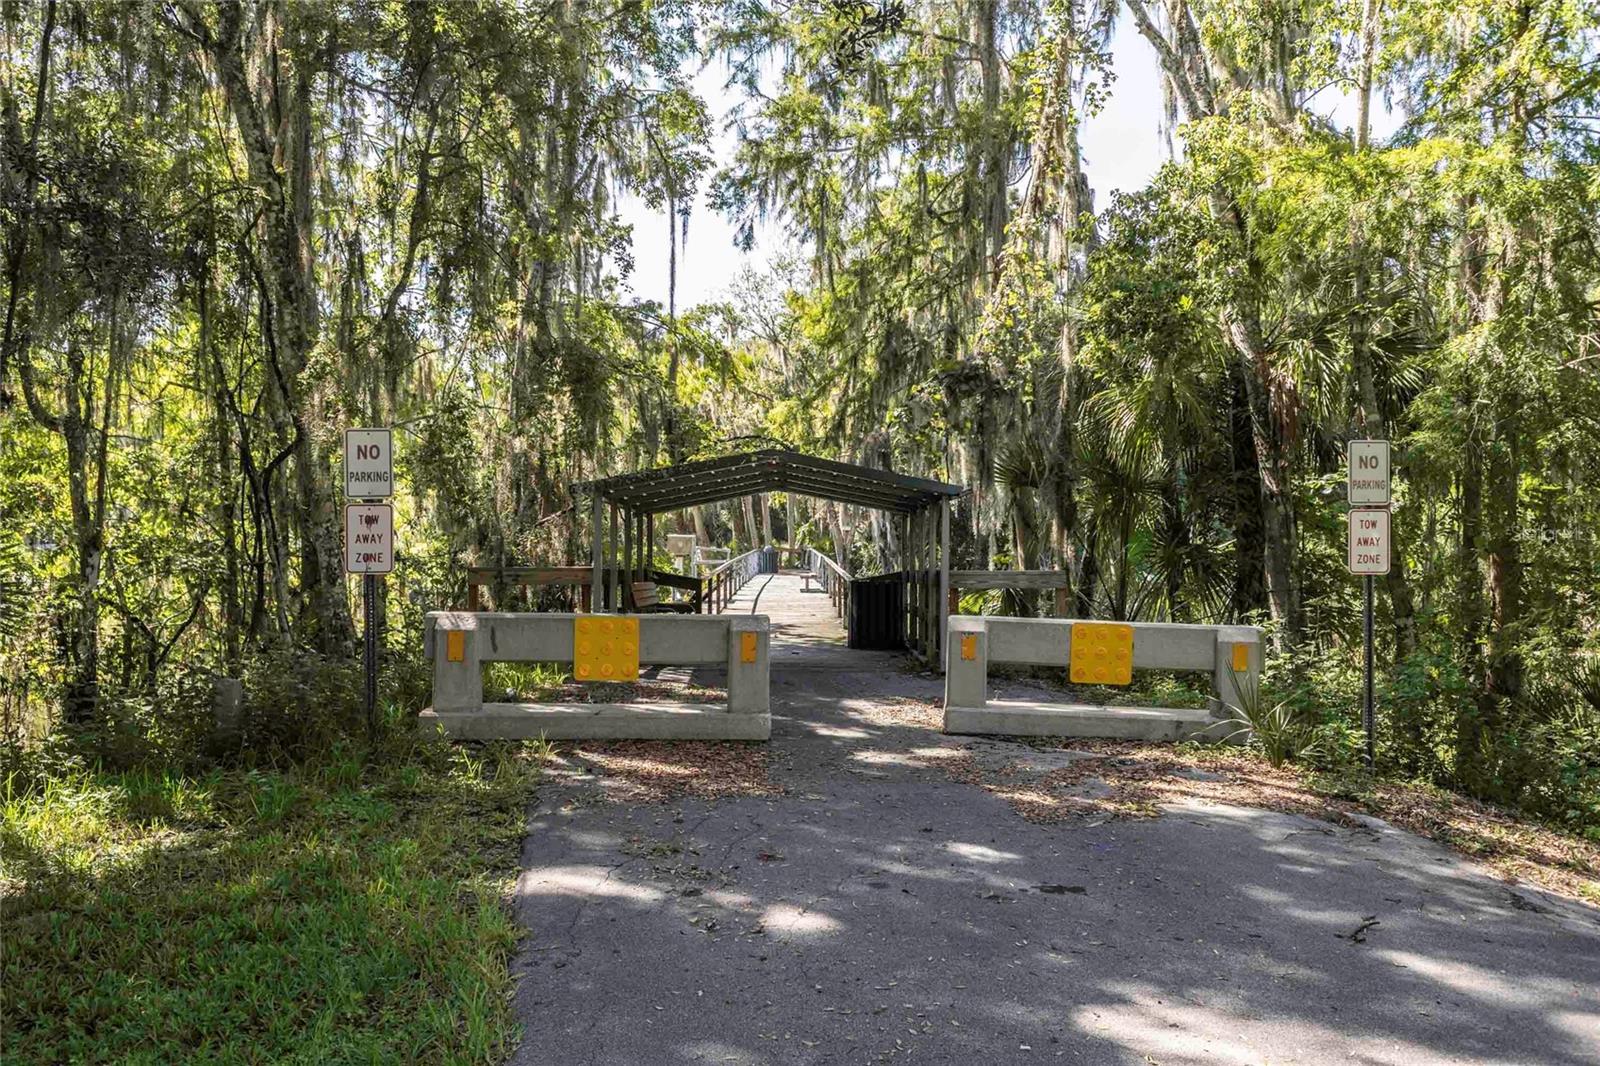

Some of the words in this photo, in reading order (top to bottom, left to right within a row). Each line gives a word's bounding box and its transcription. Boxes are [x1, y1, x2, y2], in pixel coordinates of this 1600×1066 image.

[357, 444, 380, 460] NO
[1359, 455, 1379, 469] NO
[349, 471, 389, 483] PARKING
[1352, 479, 1386, 490] PARKING
[358, 514, 380, 525] TOW
[1360, 519, 1378, 529] TOW
[355, 534, 383, 544] AWAY
[1356, 537, 1381, 547] AWAY
[355, 552, 384, 563] ZONE
[1357, 554, 1381, 564] ZONE
